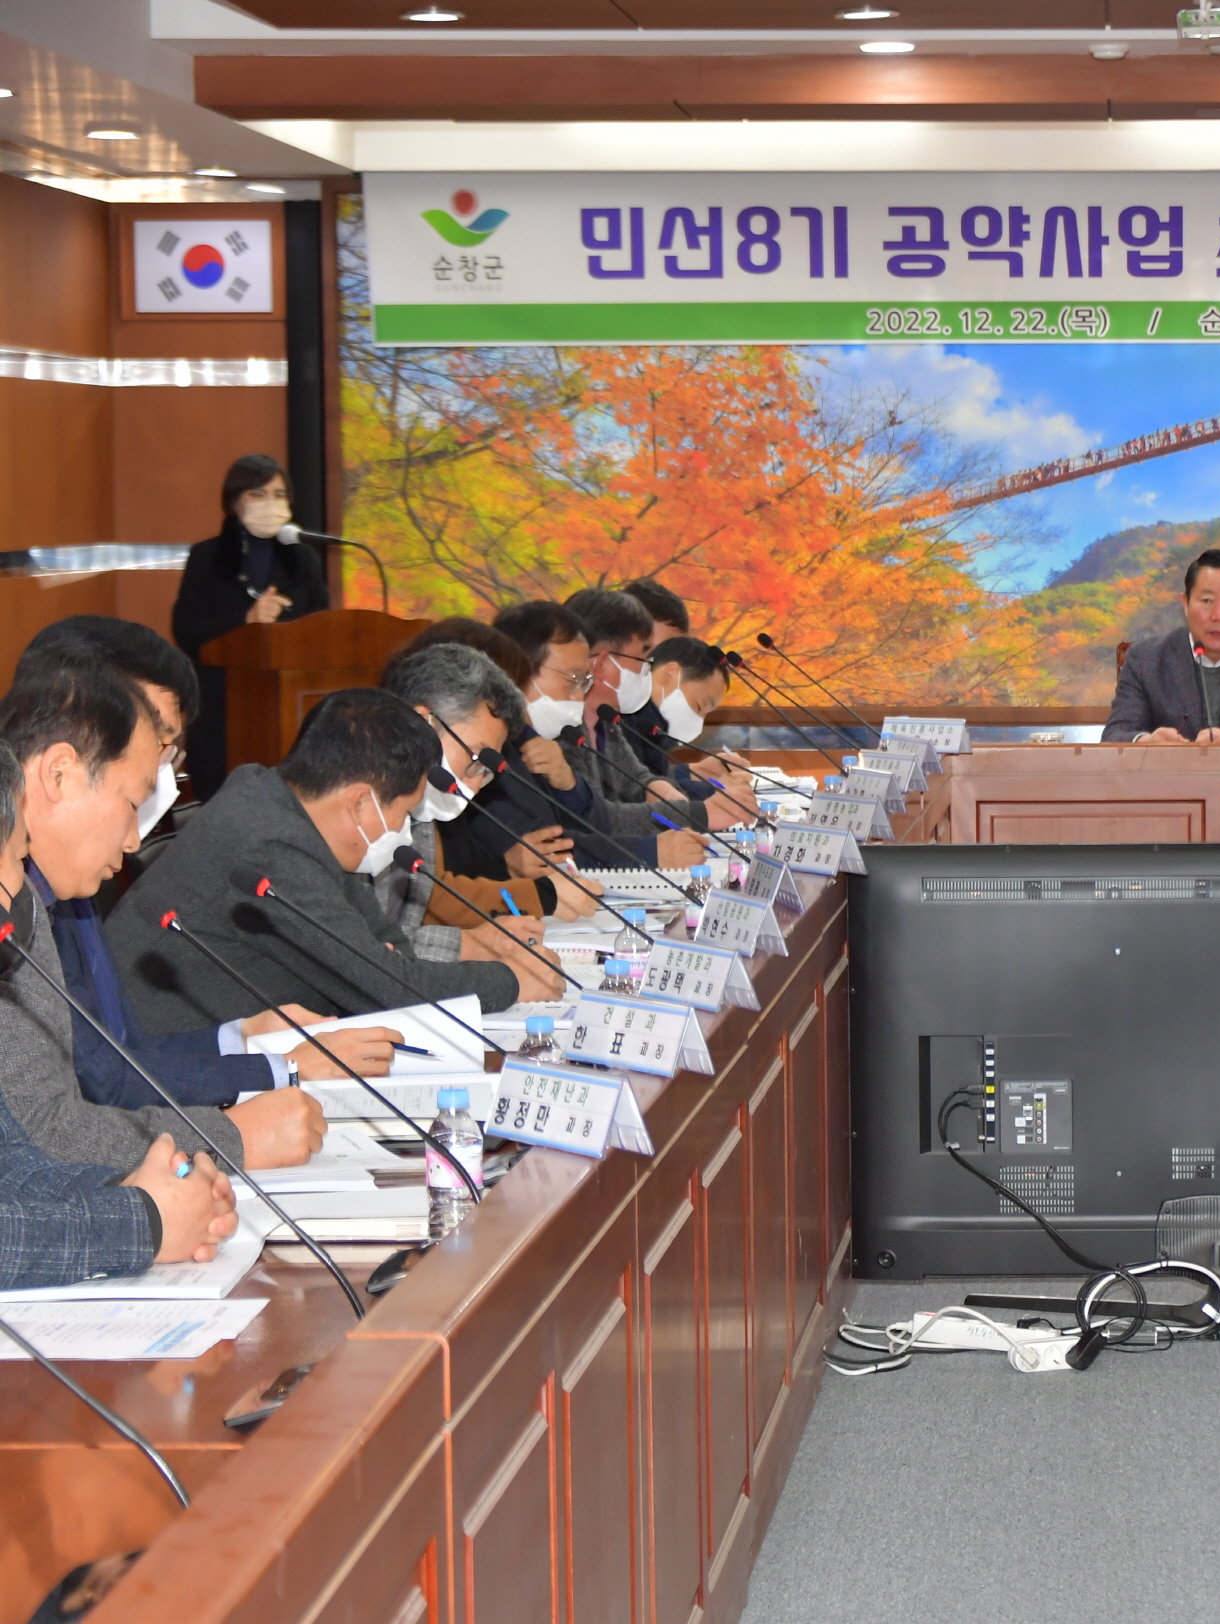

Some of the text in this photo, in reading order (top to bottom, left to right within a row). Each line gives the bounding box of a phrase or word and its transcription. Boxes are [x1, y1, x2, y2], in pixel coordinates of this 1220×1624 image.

[580, 206, 848, 280] 민선8기
[882, 204, 1184, 279] 공약사업
[432, 255, 504, 283] 순창군
[866, 309, 952, 334] 2022.
[960, 309, 1003, 334] 12.
[1011, 307, 1110, 337] 22.(목)
[522, 1074, 590, 1108] 안전재난과
